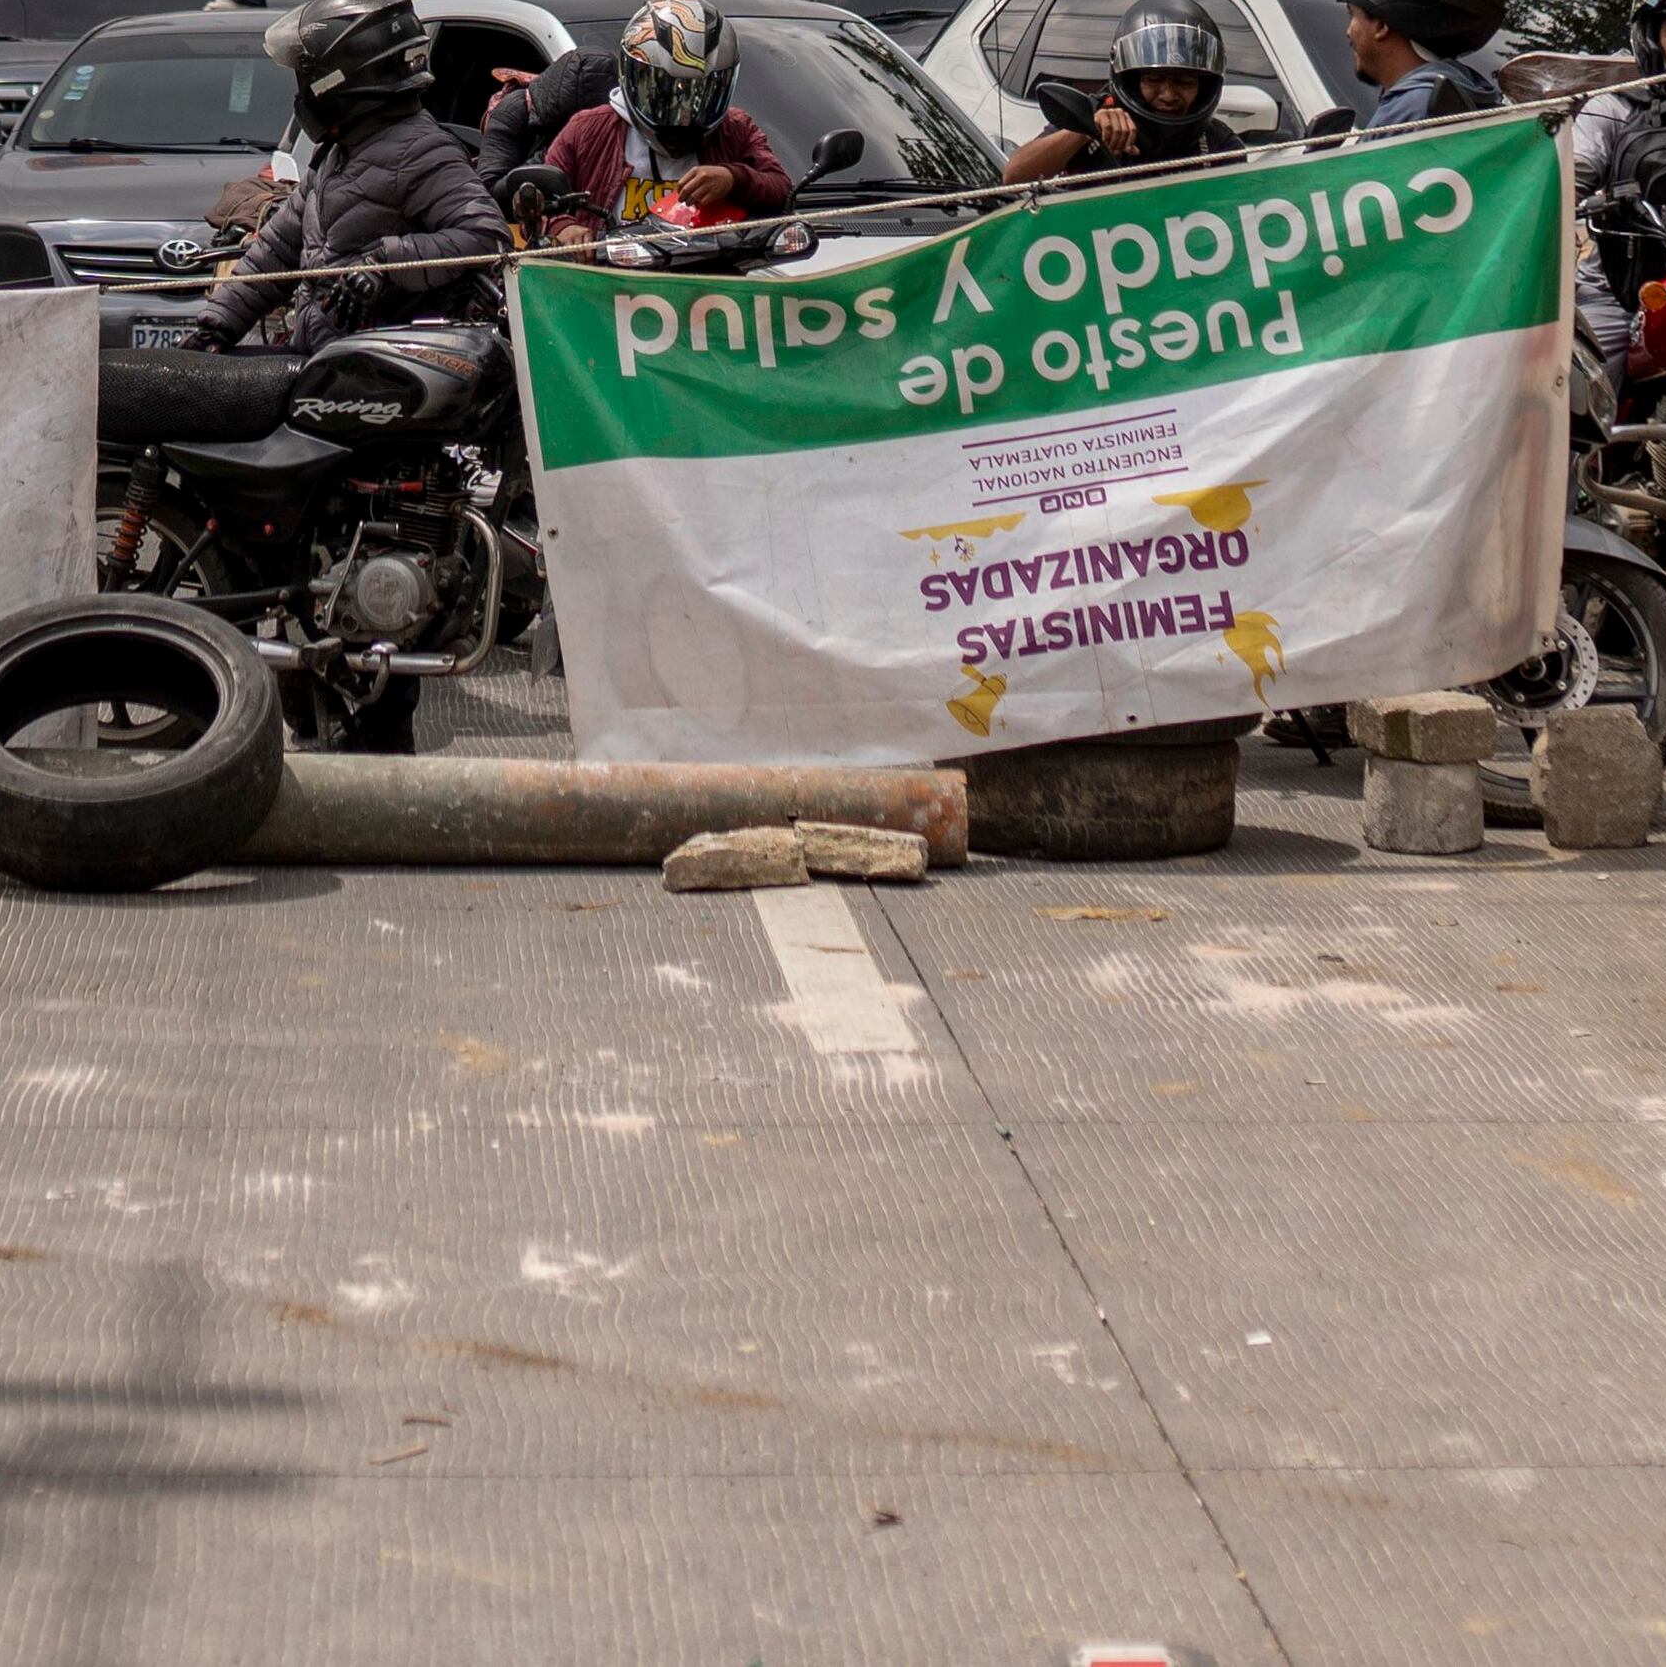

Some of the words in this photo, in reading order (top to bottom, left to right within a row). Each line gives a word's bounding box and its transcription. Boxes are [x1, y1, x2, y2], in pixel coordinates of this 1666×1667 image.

[1023, 167, 1474, 315] cuidado
[933, 236, 994, 325] y
[614, 286, 898, 378] salud
[1031, 290, 1305, 392] Puesto
[293, 398, 404, 424] Racing
[898, 344, 1006, 415] de
[969, 440, 1078, 471] GUATEMALA
[1071, 444, 1183, 476] ENCUENTRO
[1083, 422, 1178, 453] FEMINISTA
[972, 465, 1065, 493] NACIONAL
[919, 527, 1250, 612] ORGANIZADAS
[956, 590, 1236, 665] FEMINISTAS
